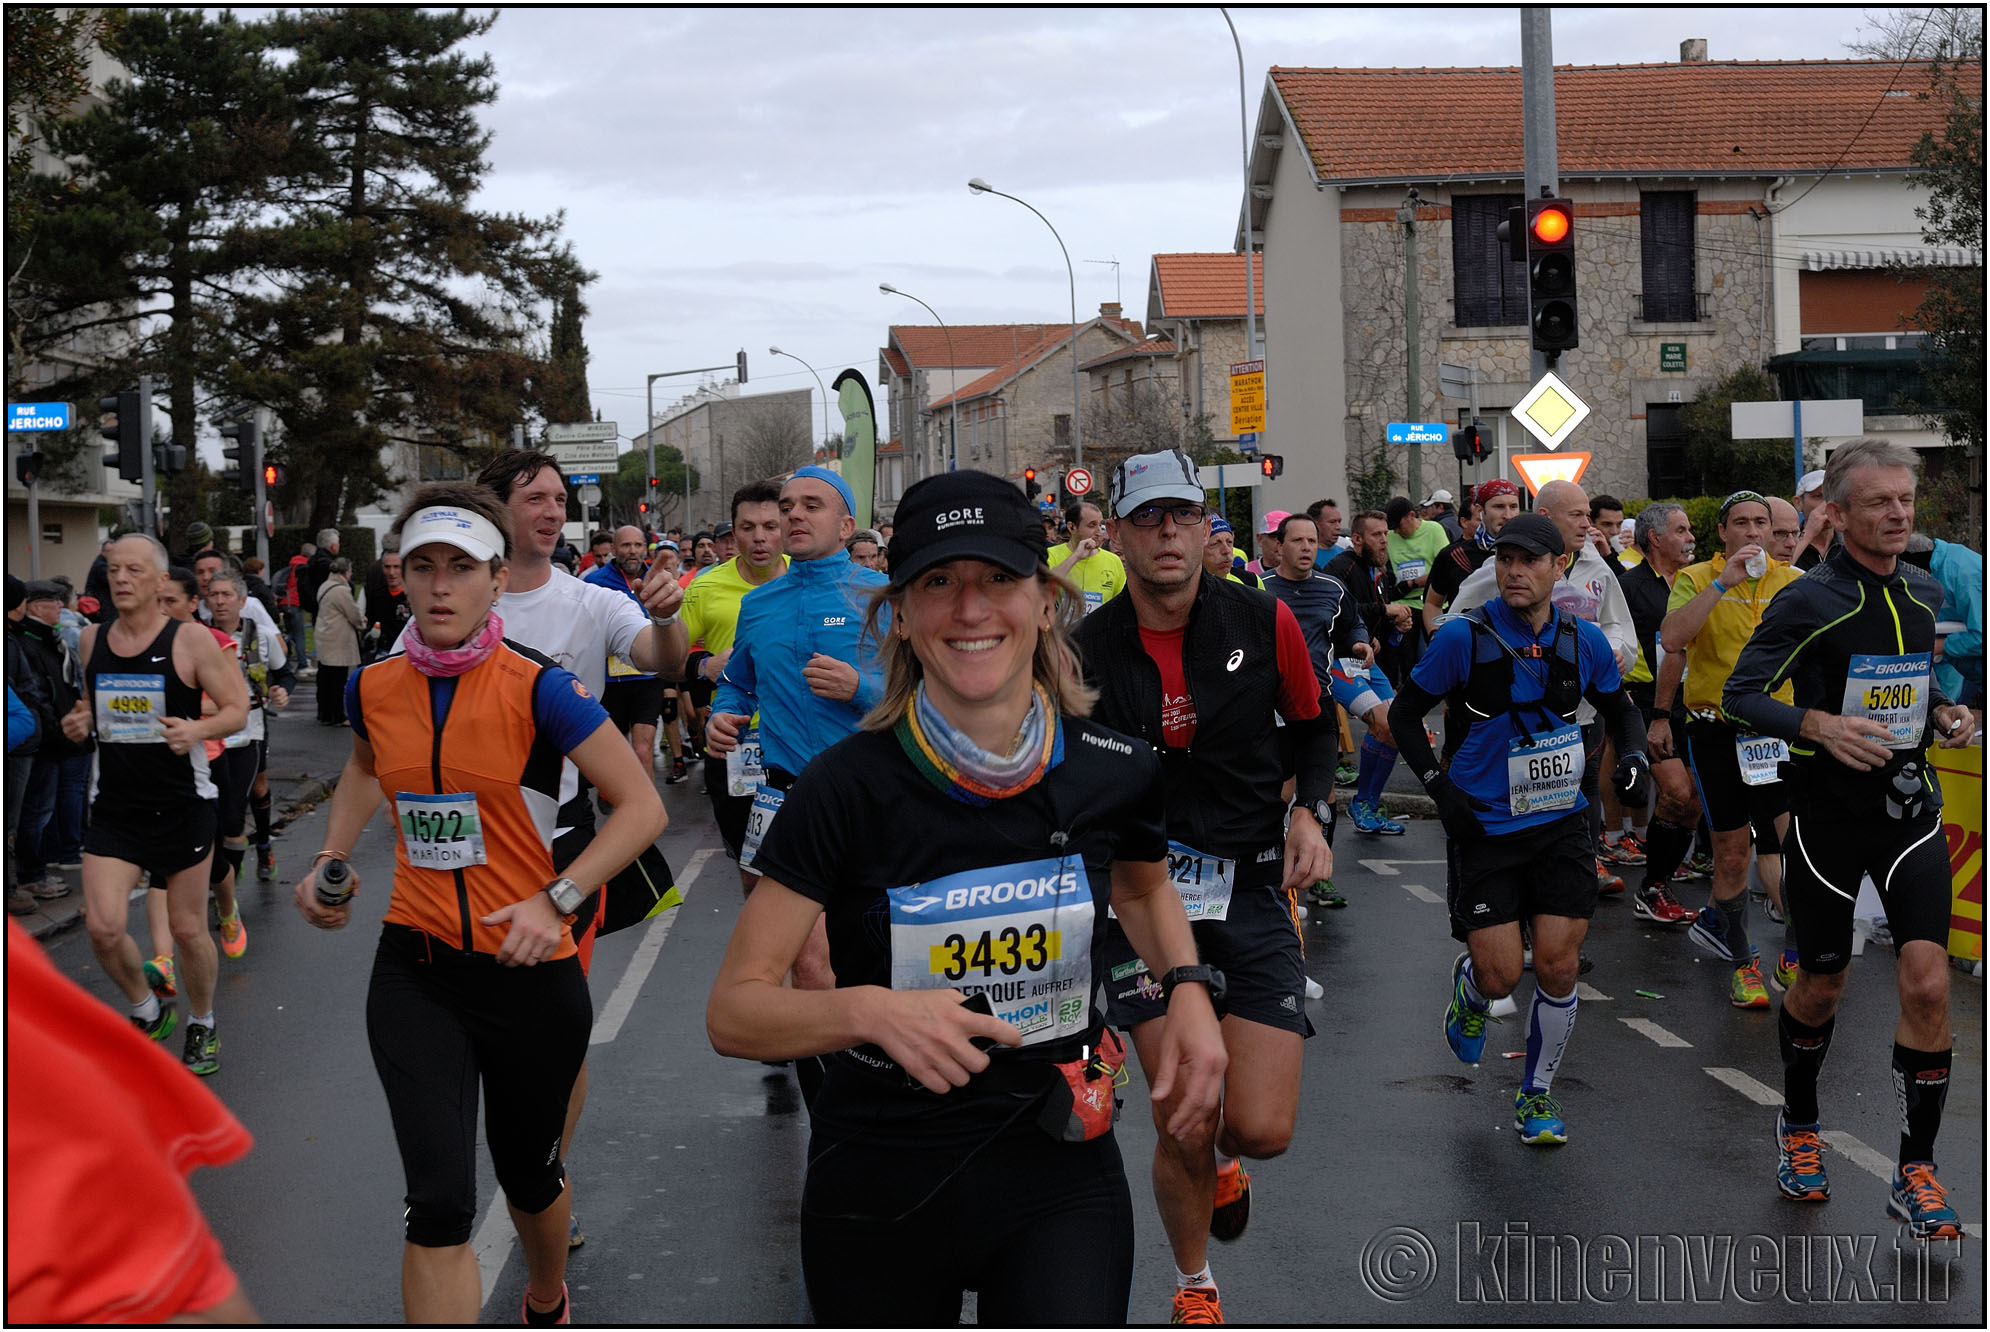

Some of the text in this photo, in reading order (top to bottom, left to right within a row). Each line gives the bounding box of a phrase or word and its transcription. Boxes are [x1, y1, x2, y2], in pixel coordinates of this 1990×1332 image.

[1231, 362, 1263, 375] ATTENTION
[1234, 377, 1261, 386] MARATHON
[16, 406, 36, 416] RUE
[1250, 403, 1263, 411] VILLE
[936, 508, 984, 524] GORE
[823, 616, 846, 624] GORE
[1874, 660, 1929, 675] BROOKS
[113, 680, 161, 689] BROOKS
[112, 695, 149, 714] 4938
[1868, 683, 1912, 711] 5280
[1081, 731, 1133, 755] newline
[1745, 741, 1781, 762] 3028
[1528, 752, 1573, 781] 6662
[1530, 788, 1577, 805] MARATHON
[407, 809, 467, 843] 1522
[944, 872, 1078, 910] BROOKS
[943, 923, 1048, 981] 3433
[1031, 977, 1074, 997] AUFFRET
[1058, 999, 1083, 1016] 29
[1926, 1077, 1948, 1086] SPORT
